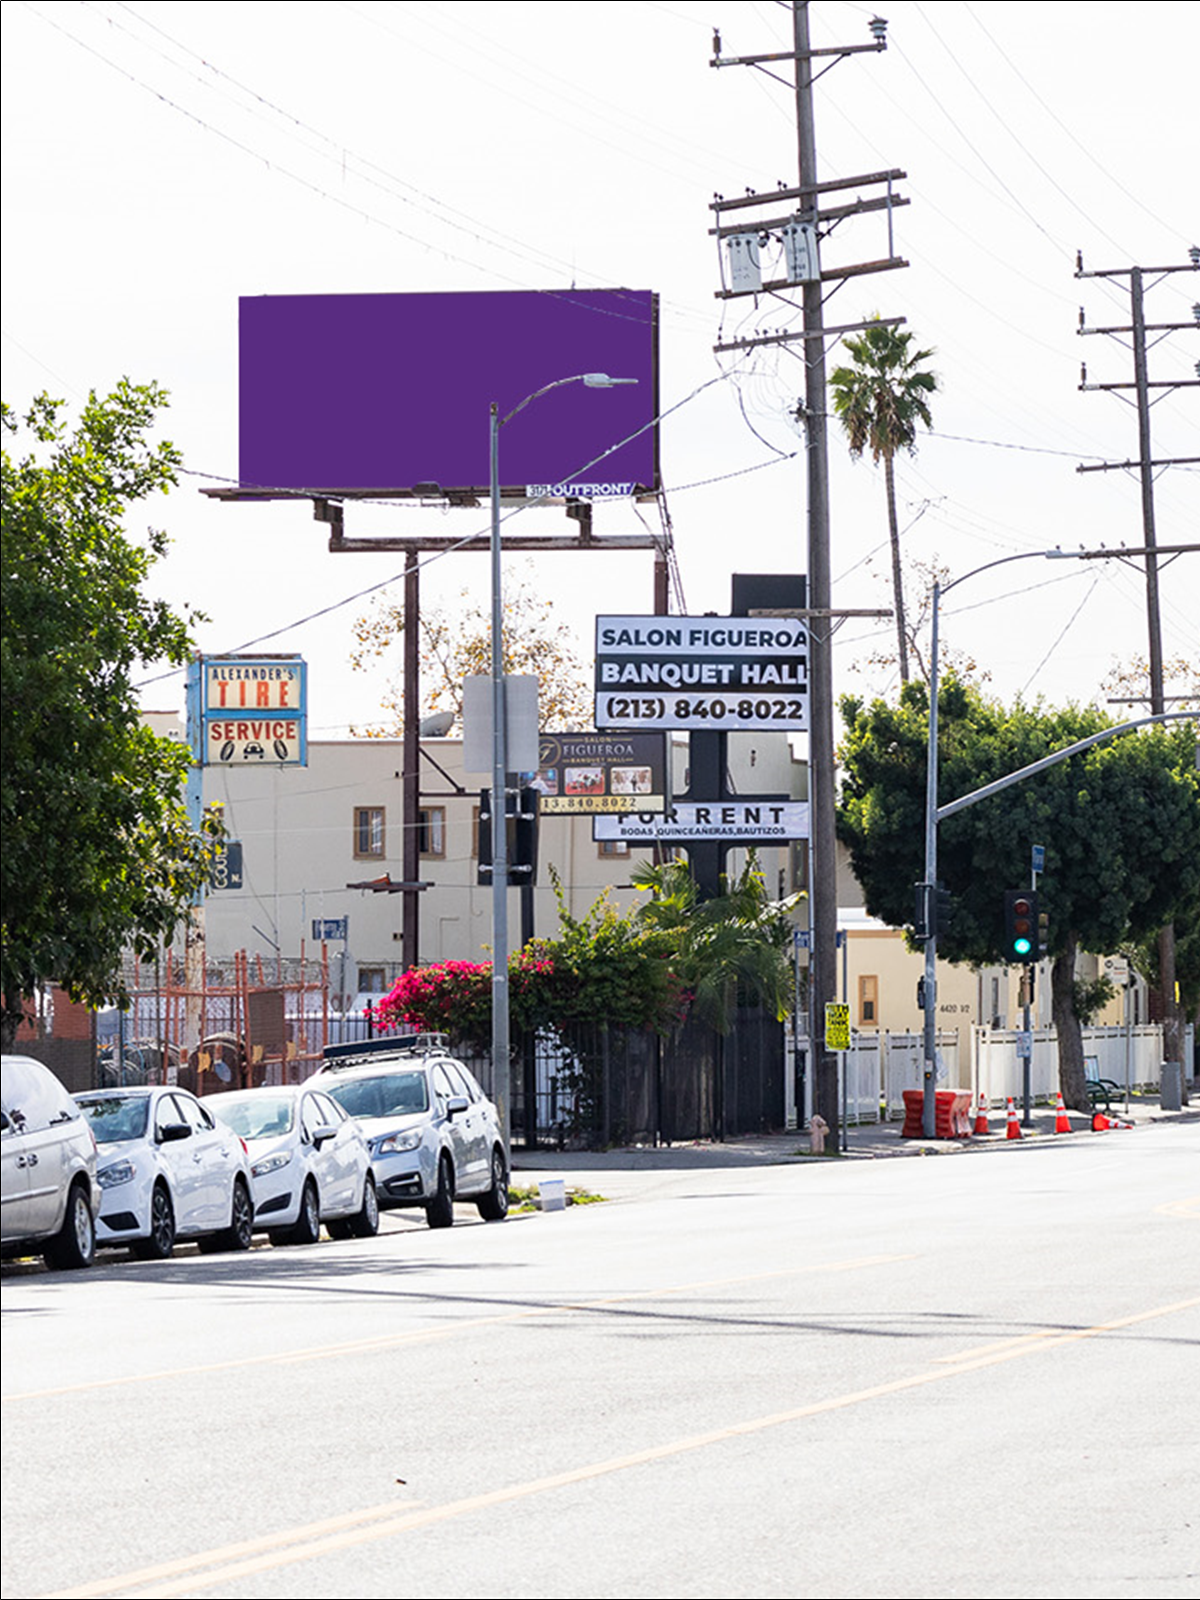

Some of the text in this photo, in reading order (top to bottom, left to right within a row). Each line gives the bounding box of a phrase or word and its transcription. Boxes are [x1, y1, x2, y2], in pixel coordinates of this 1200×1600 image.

[553, 484, 630, 496] OUTFRONT
[602, 629, 807, 647] SALON FIGUEROA
[212, 668, 294, 680] ALEXANDER'S
[602, 663, 807, 688] BANQUET HALL
[217, 681, 289, 707] TIRE
[607, 697, 803, 719] (213) 840-8022
[211, 721, 296, 741] SERVICE
[563, 744, 634, 756] FIGUEROA
[696, 807, 785, 824] RENT
